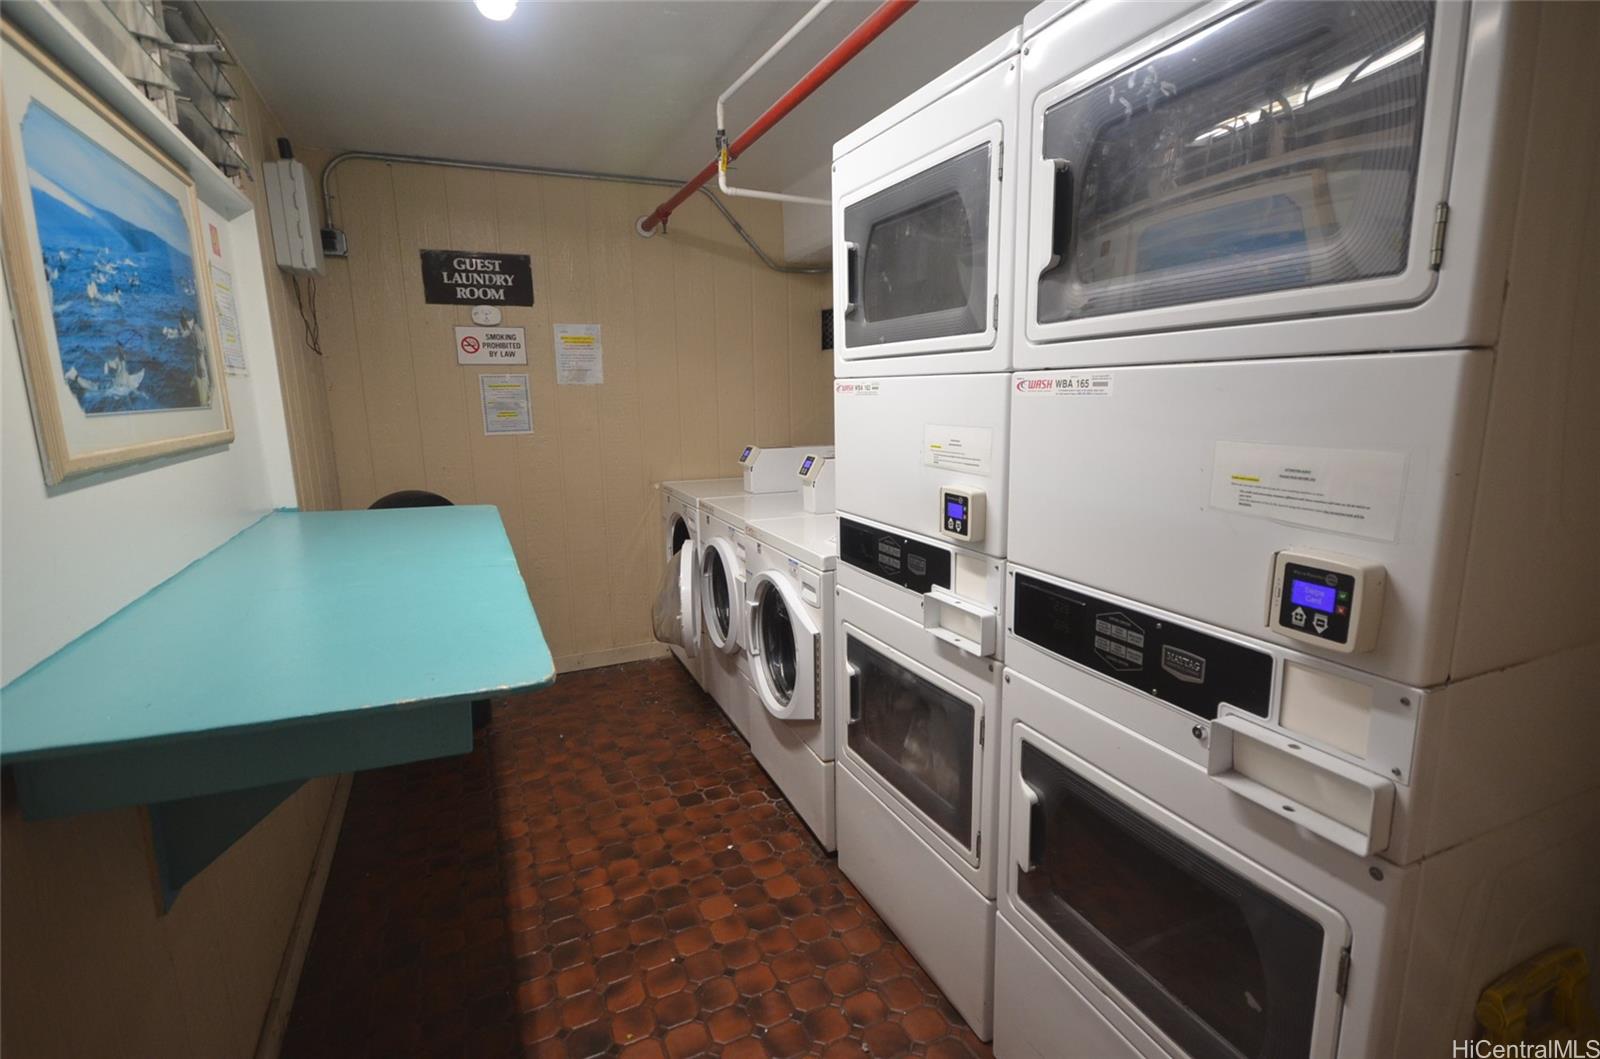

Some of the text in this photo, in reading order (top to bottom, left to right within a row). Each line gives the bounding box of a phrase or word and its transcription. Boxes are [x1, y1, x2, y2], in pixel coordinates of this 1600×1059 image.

[453, 257, 502, 272] GUEST
[442, 271, 515, 287] LAUNDRY
[456, 287, 506, 301] ROOM
[485, 333, 517, 341] SMOKING
[482, 342, 521, 351] PROHIBITED
[488, 350, 517, 359] BY LAW
[1027, 378, 1090, 389] WASH WBA 165
